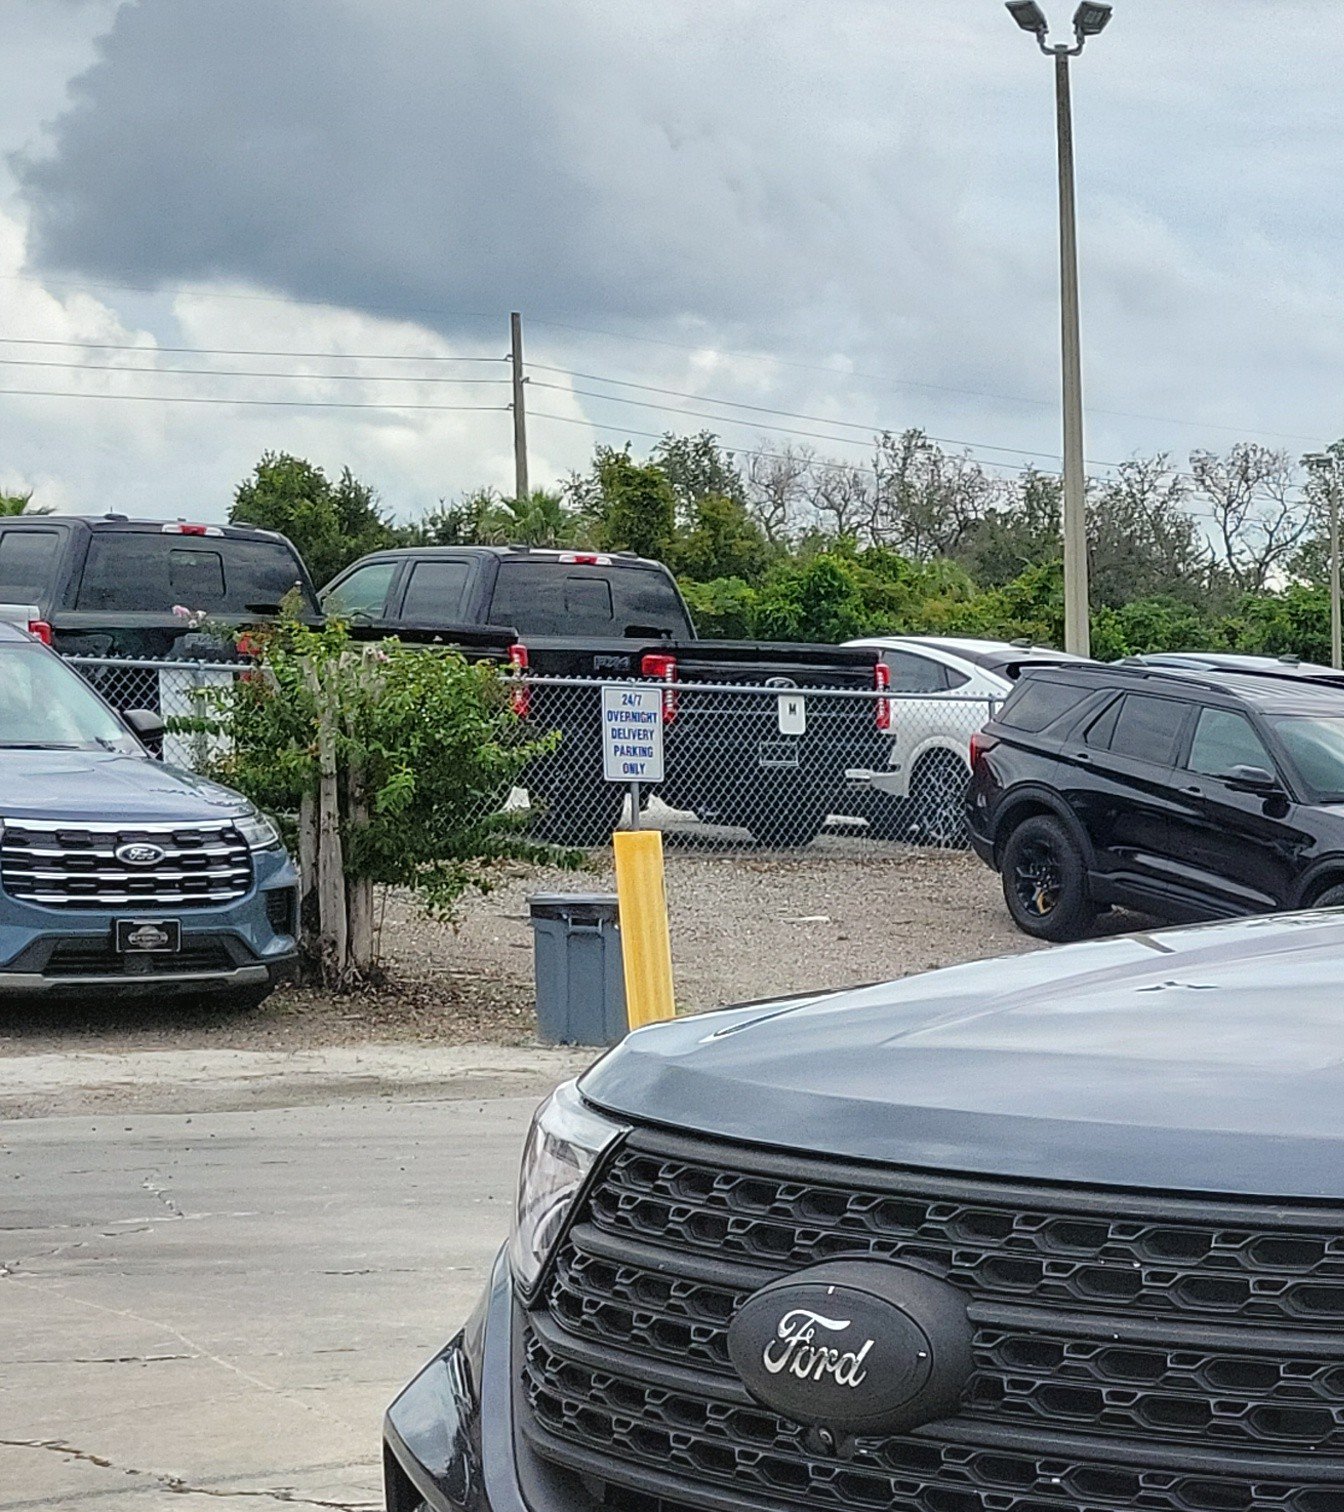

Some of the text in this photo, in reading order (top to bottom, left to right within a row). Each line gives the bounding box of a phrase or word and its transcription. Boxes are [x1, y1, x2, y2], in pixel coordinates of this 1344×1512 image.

[621, 694, 642, 706] 24/7
[607, 710, 657, 724] OVERNIGHT
[611, 728, 654, 740] DELIVERY
[613, 745, 654, 758] PARKING
[622, 762, 646, 775] ONLY
[129, 847, 157, 860] Ford
[763, 1309, 875, 1388] Ford
